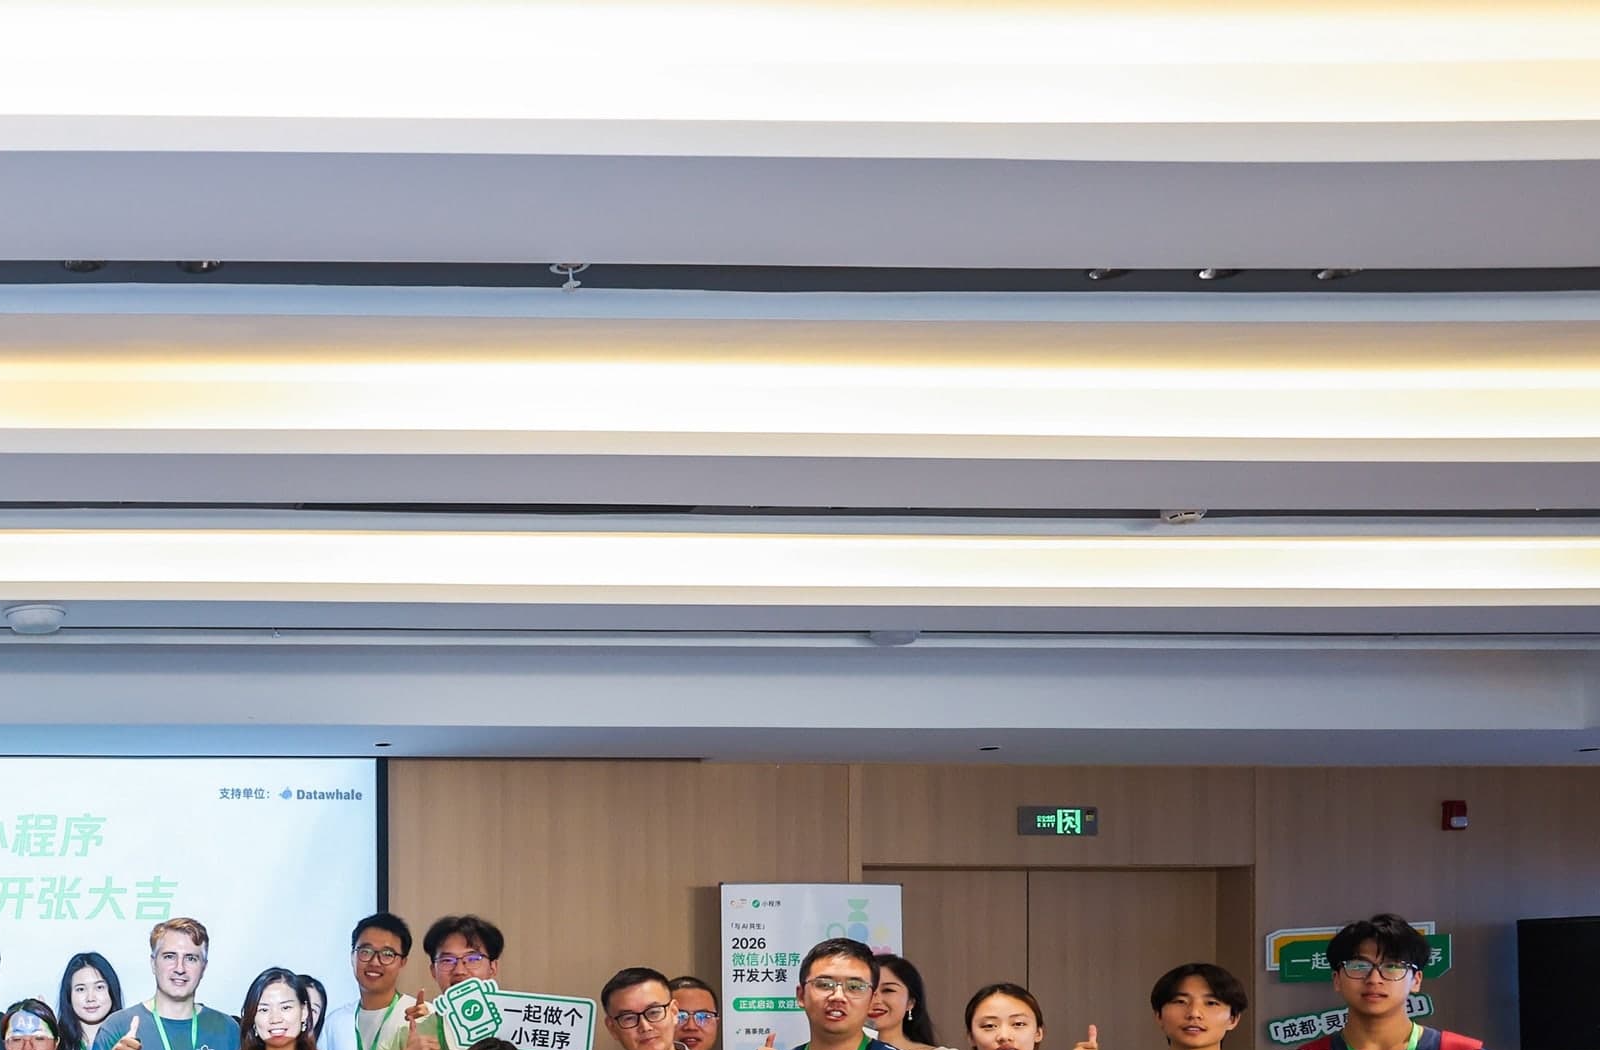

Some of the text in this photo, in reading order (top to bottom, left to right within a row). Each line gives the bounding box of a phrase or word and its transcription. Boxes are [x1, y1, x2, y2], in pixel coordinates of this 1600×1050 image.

[296, 789, 362, 801] Datawhale
[732, 937, 766, 950] 2026
[732, 953, 800, 967] 微信小程序
[732, 968, 788, 983] 开发大赛
[503, 1004, 583, 1027] 一起做个
[511, 1028, 571, 1049] 小程序
